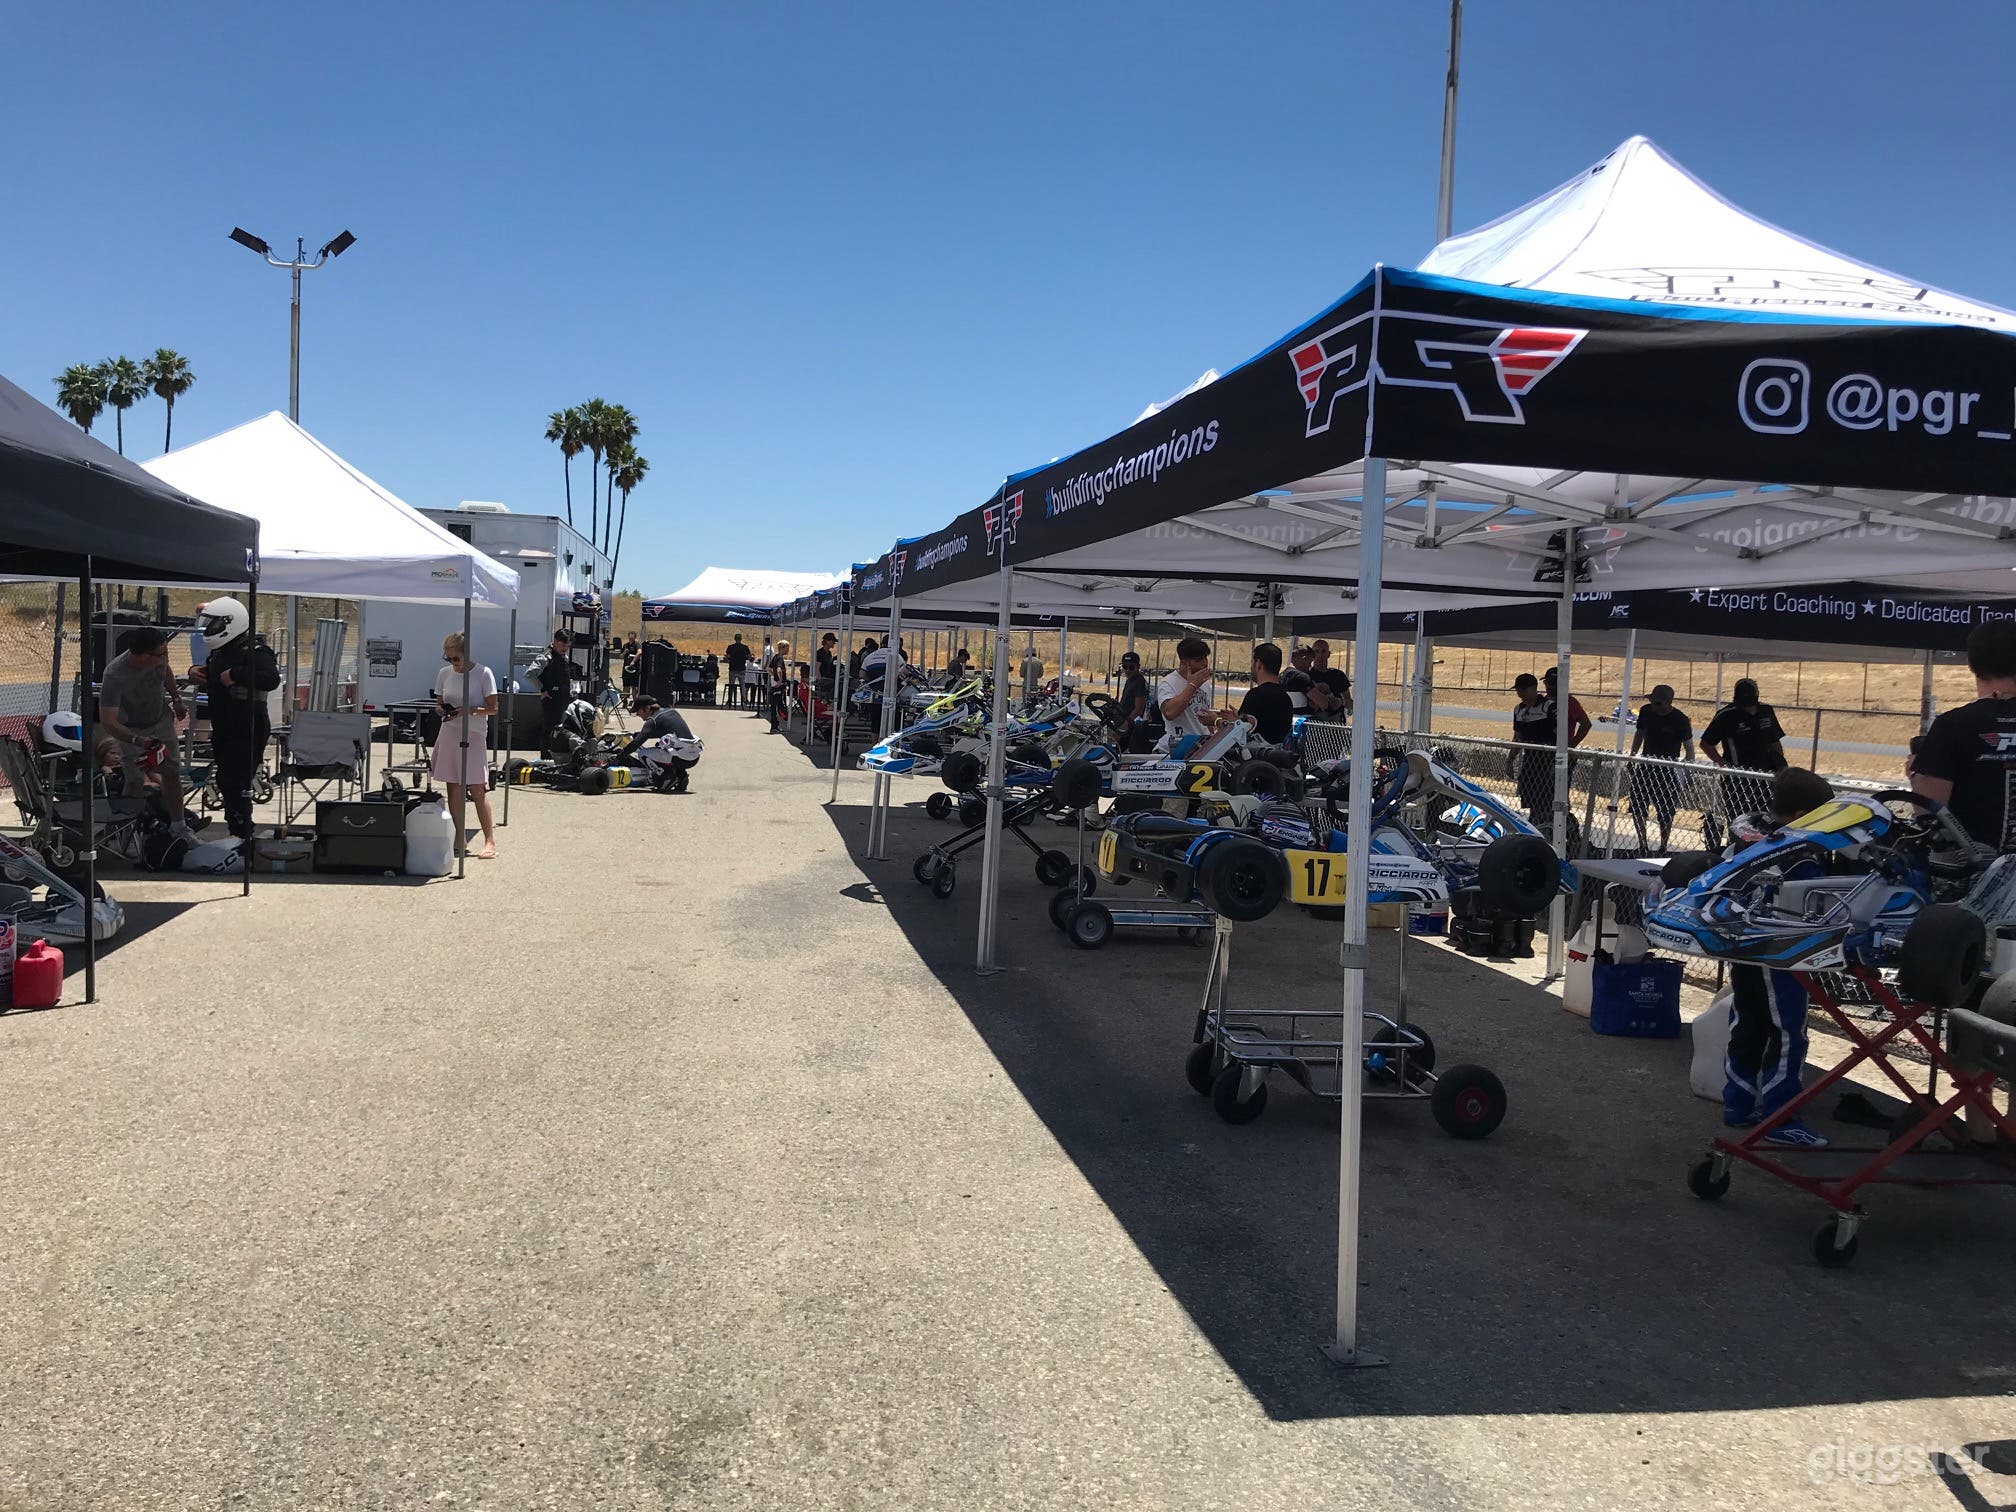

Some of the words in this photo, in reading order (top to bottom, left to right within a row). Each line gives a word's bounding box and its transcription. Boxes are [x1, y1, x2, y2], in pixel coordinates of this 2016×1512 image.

[1827, 374, 2016, 439] @pgr_
[1045, 420, 1220, 519] #buildingchampions
[1707, 588, 1768, 612] Expert
[1774, 592, 1856, 620] Coaching
[1881, 599, 1971, 624] Dedicated
[1977, 606, 2016, 624] Trac
[1189, 765, 1215, 793] 2
[1304, 858, 1331, 897] 17
